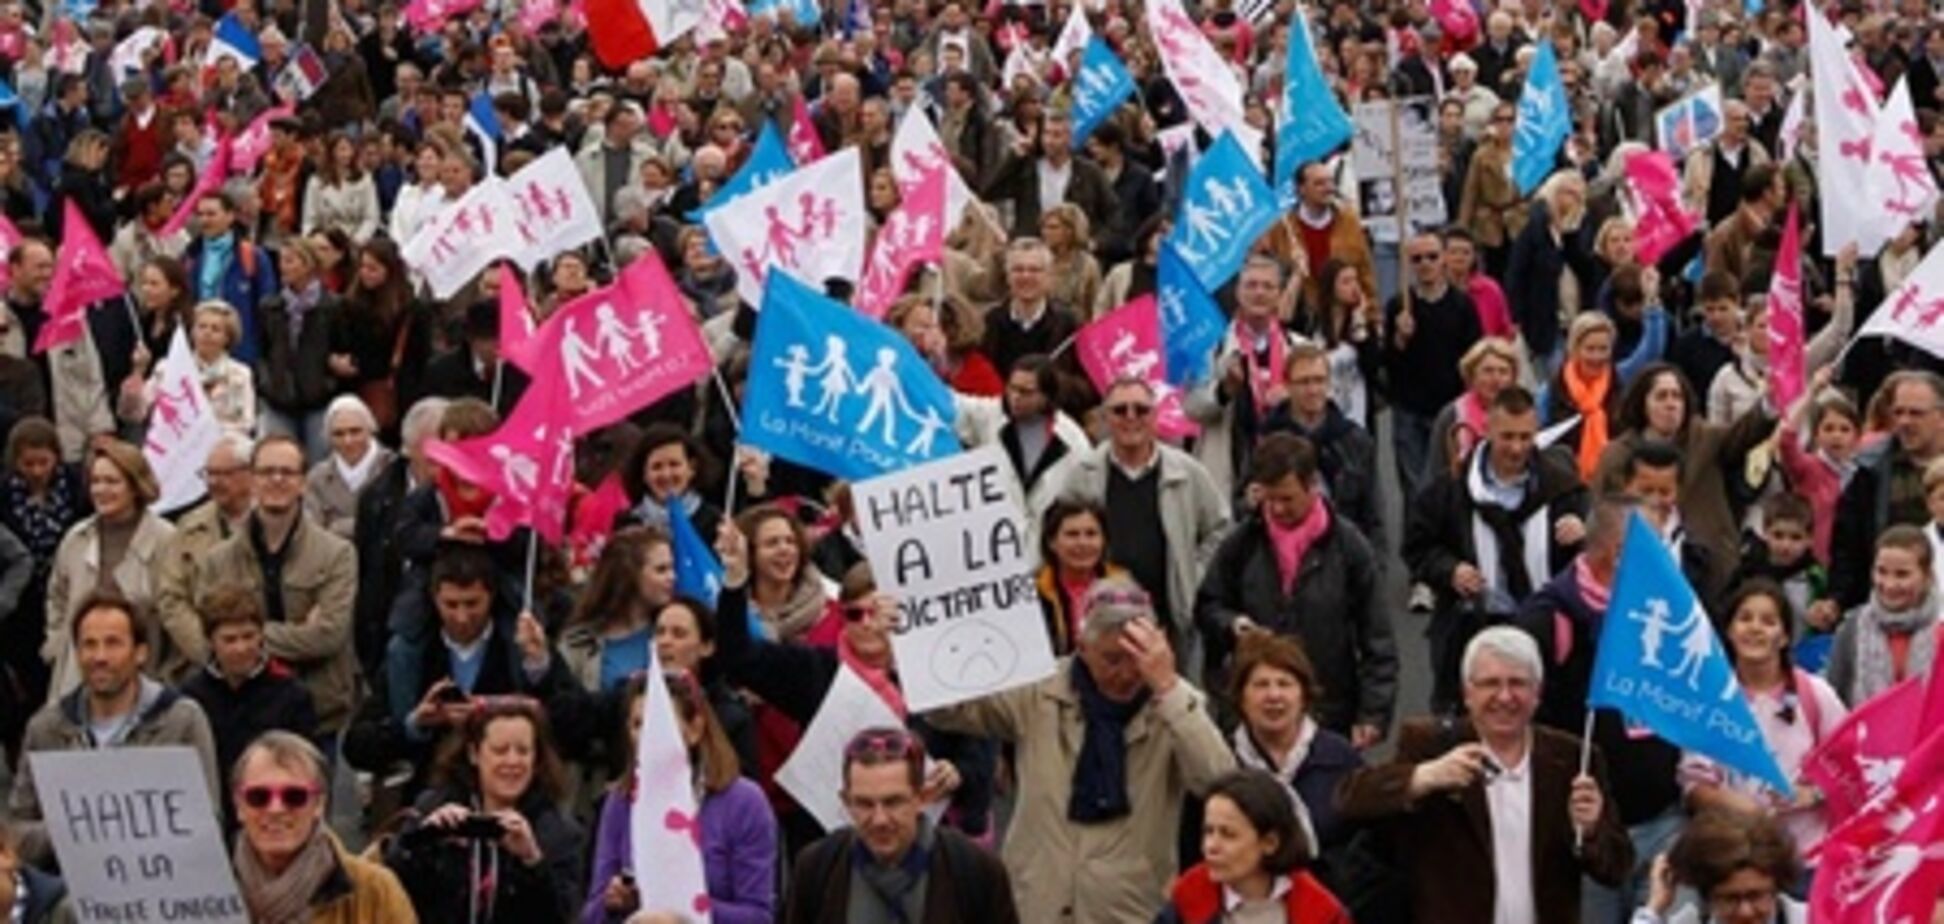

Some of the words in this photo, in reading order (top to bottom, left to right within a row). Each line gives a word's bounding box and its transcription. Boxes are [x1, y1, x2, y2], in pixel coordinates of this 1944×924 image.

[760, 410, 788, 434] La
[868, 465, 1005, 532] HALTE
[894, 538, 932, 586] A
[961, 517, 1022, 571] LA
[1605, 670, 1635, 697] La
[1637, 679, 1705, 722] Manif
[60, 789, 194, 844] HALTE
[105, 854, 128, 884] A
[138, 853, 175, 882] LA
